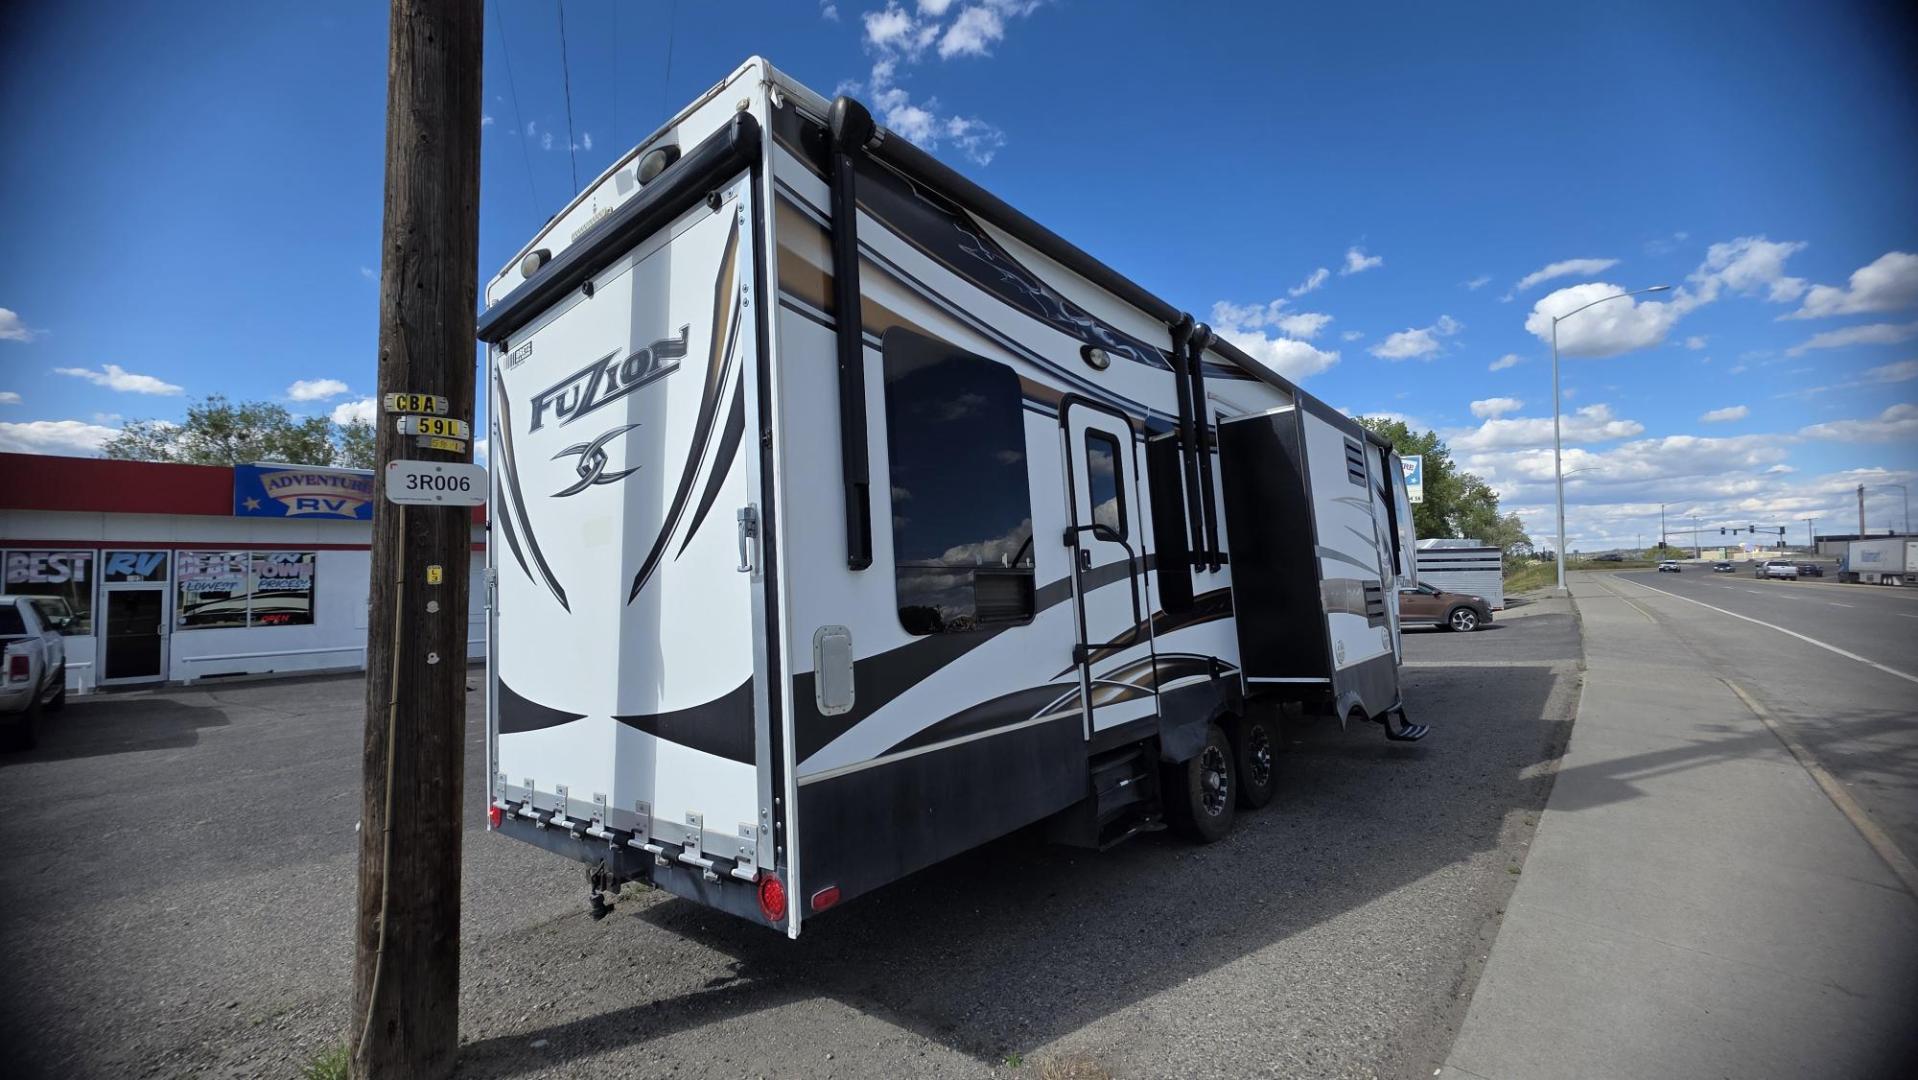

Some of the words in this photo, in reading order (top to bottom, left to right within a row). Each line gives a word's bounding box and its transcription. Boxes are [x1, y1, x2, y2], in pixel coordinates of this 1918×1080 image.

[396, 395, 434, 412] CBA
[420, 418, 456, 436] 59L
[406, 474, 470, 491] 3R006
[296, 498, 346, 511] RV
[7, 552, 92, 583] BEST
[106, 552, 165, 576] RV
[186, 581, 239, 591] LOWEST
